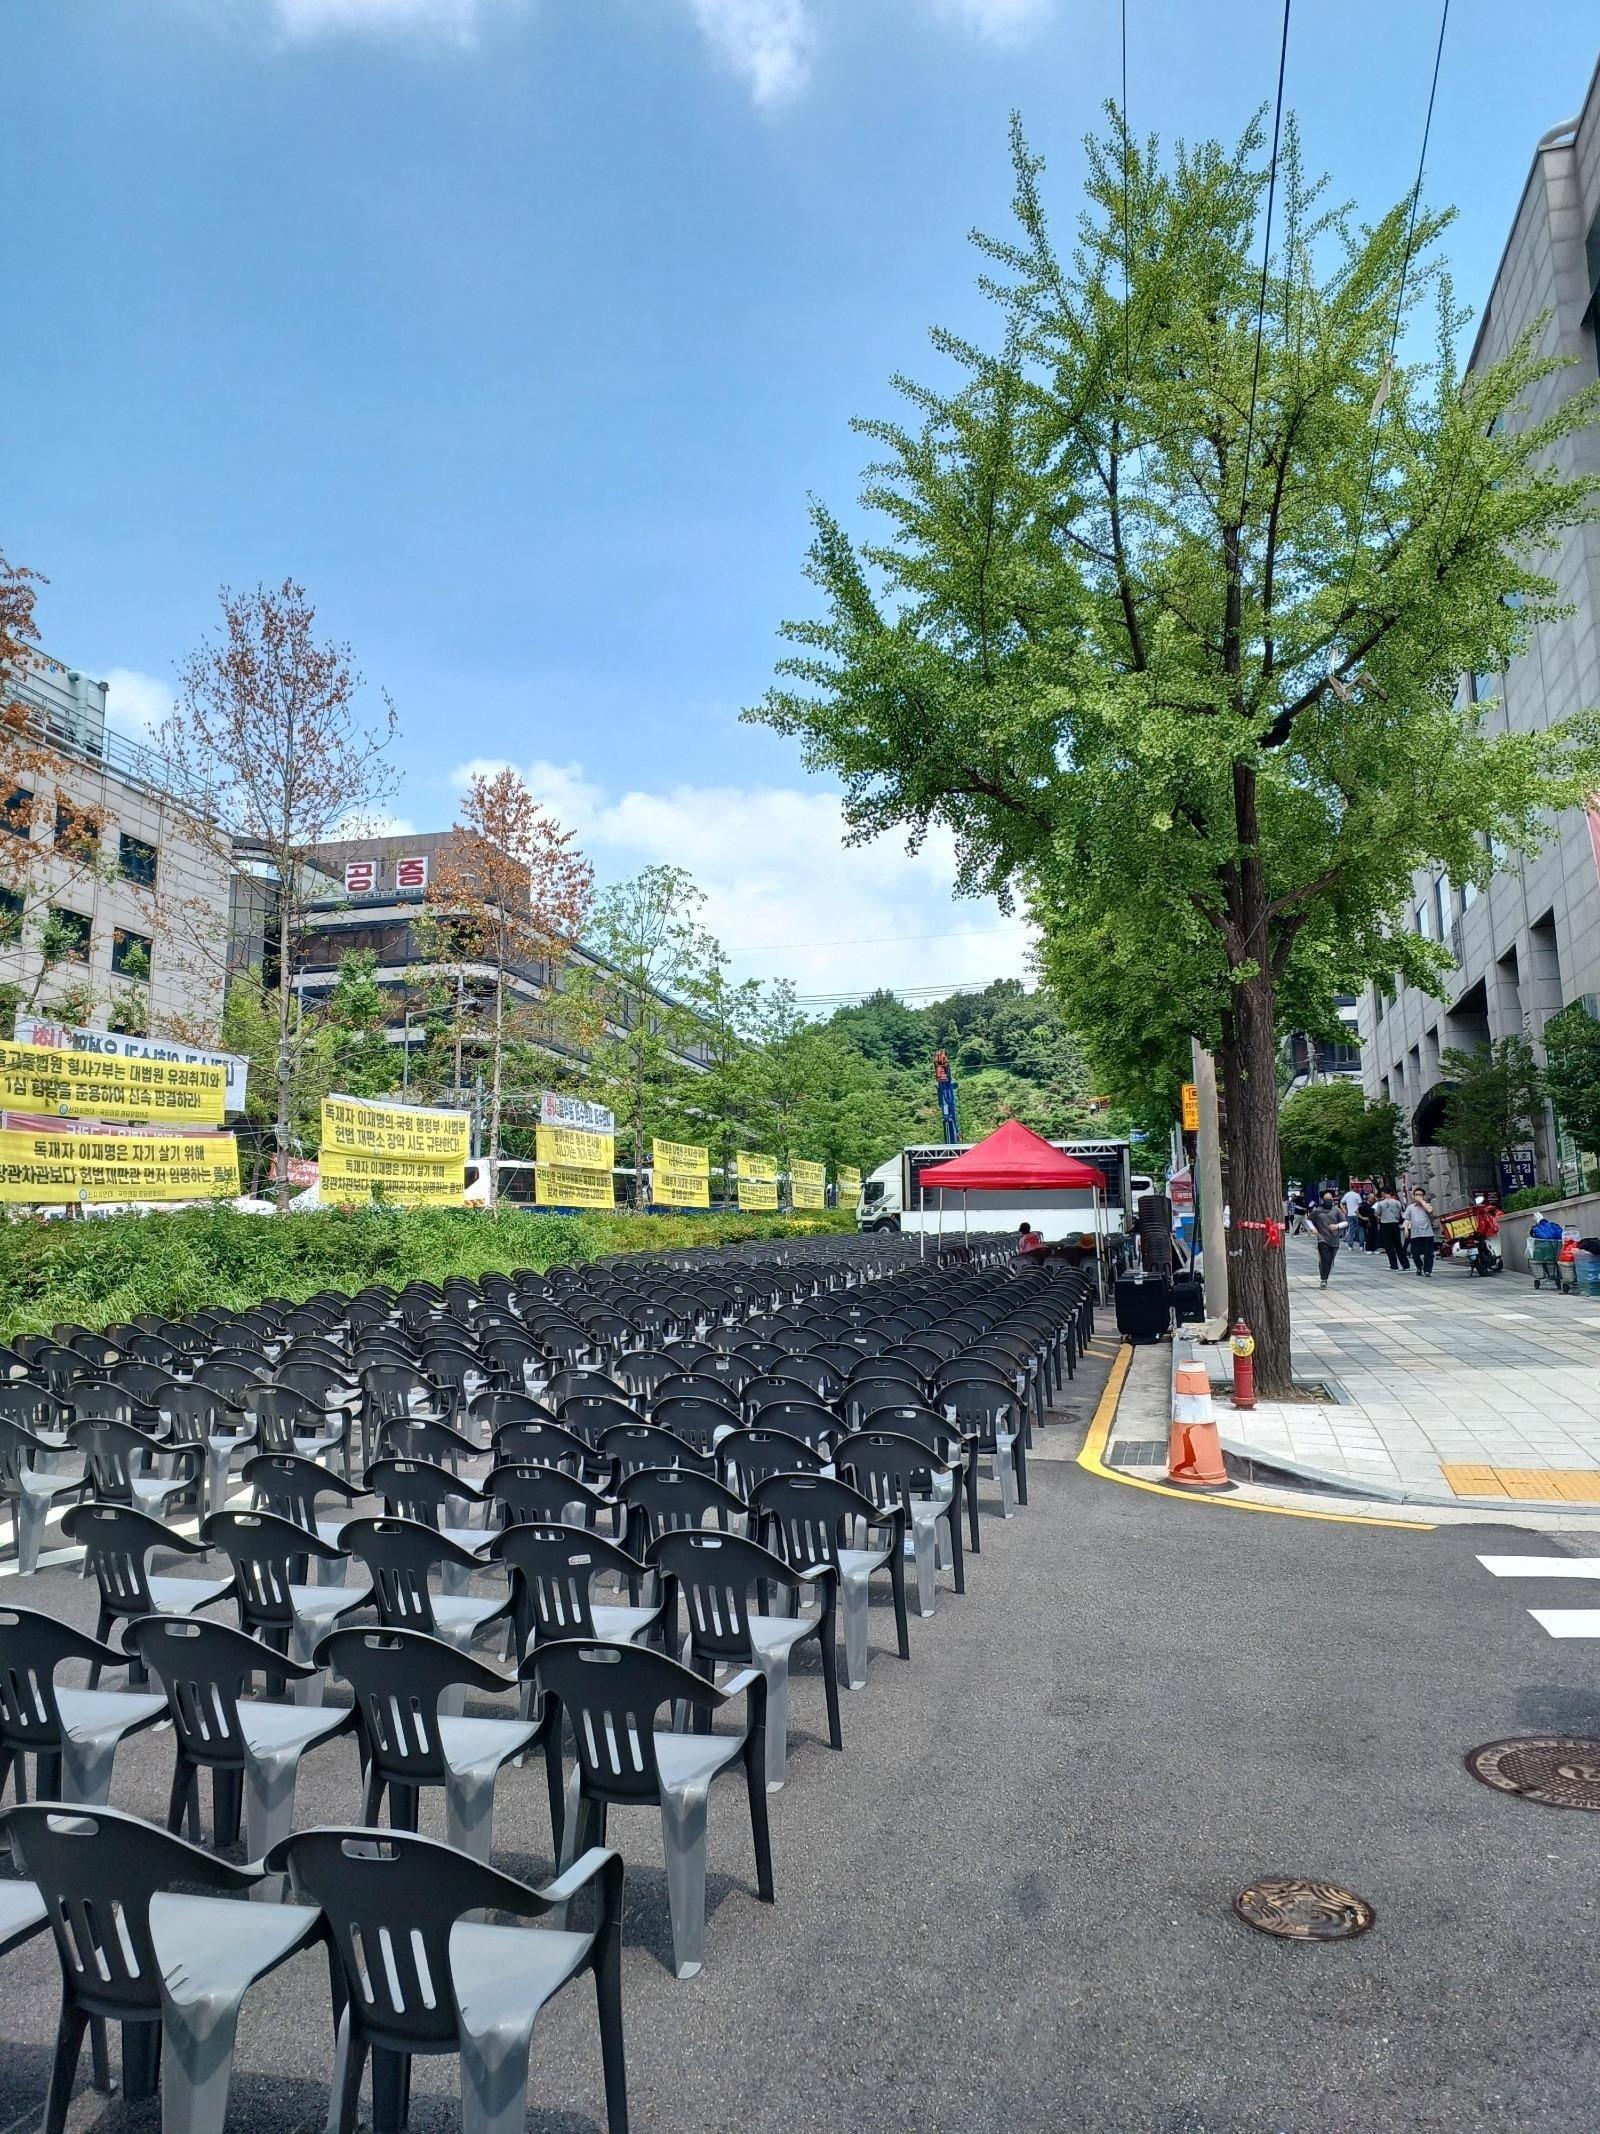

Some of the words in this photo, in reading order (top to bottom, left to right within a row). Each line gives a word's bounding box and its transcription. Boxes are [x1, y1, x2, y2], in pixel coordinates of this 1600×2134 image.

[347, 860, 425, 891] 공증
[68, 1058, 125, 1080] 형사7부는
[130, 1065, 164, 1084] 대법원
[168, 1069, 220, 1088] 유죄취지와
[5, 1077, 26, 1096] 1심
[76, 1083, 125, 1104] 준용하여
[129, 1088, 151, 1106] 신속
[155, 1090, 200, 1108] 판결하라!
[326, 1104, 355, 1125] 독재자
[358, 1110, 394, 1130] 이재명의
[396, 1116, 413, 1132] 국회
[34, 1141, 75, 1160] 독재자
[79, 1143, 128, 1161] 이재명은
[132, 1145, 155, 1161] 자기
[159, 1145, 180, 1161] 살기
[184, 1145, 205, 1161] 위해
[335, 1125, 355, 1144] 헌법
[357, 1129, 385, 1148] 재판소
[387, 1133, 405, 1150] 장악
[408, 1134, 424, 1151] 시도
[427, 1136, 460, 1152] 규탄한다!
[79, 1166, 141, 1185] 헌법재판관
[144, 1167, 166, 1185] 먼저
[170, 1167, 211, 1184] 임명하는
[345, 1160, 368, 1174] 독재자
[371, 1161, 399, 1176] 이재명은
[402, 1163, 415, 1177] 자기
[417, 1165, 430, 1177] 살기
[432, 1165, 445, 1177] 위해
[322, 1176, 369, 1191] 장관차관보다
